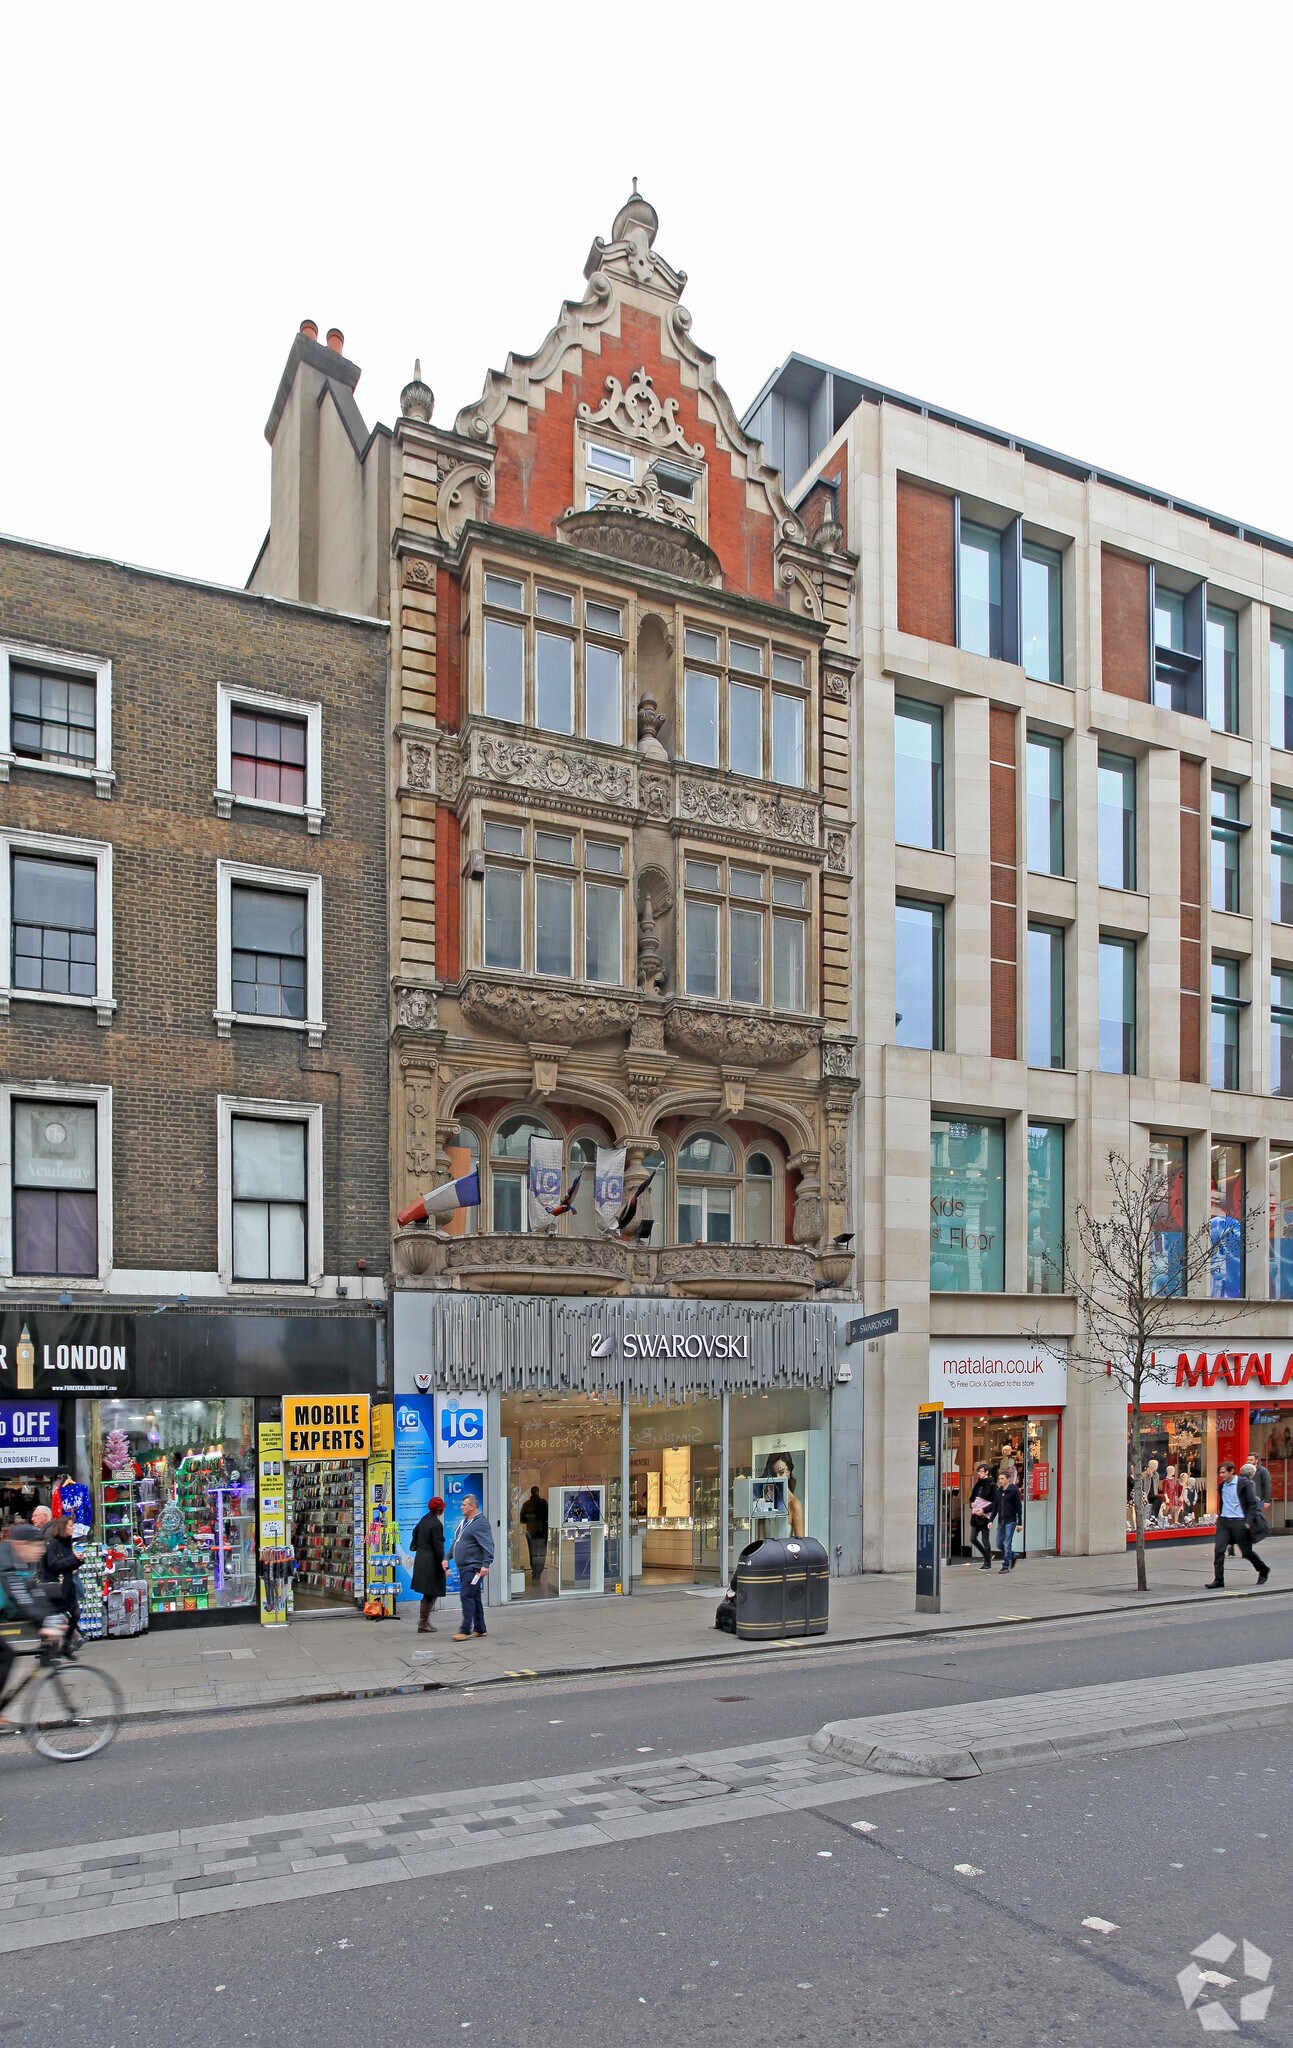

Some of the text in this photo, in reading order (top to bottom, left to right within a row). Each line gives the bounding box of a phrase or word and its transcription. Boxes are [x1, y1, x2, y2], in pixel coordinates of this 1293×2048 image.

[24, 1161, 90, 1183] Academy
[950, 1227, 995, 1250] Floor
[860, 1317, 892, 1334] SWAROVSKI
[623, 1333, 748, 1358] SWAROVSKI
[43, 1344, 126, 1370] LONDON
[943, 1356, 1044, 1374] matalan.co.uk
[13, 1412, 51, 1436] OFF
[295, 1405, 359, 1425] MOBILE
[290, 1429, 364, 1451] EXPERTS
